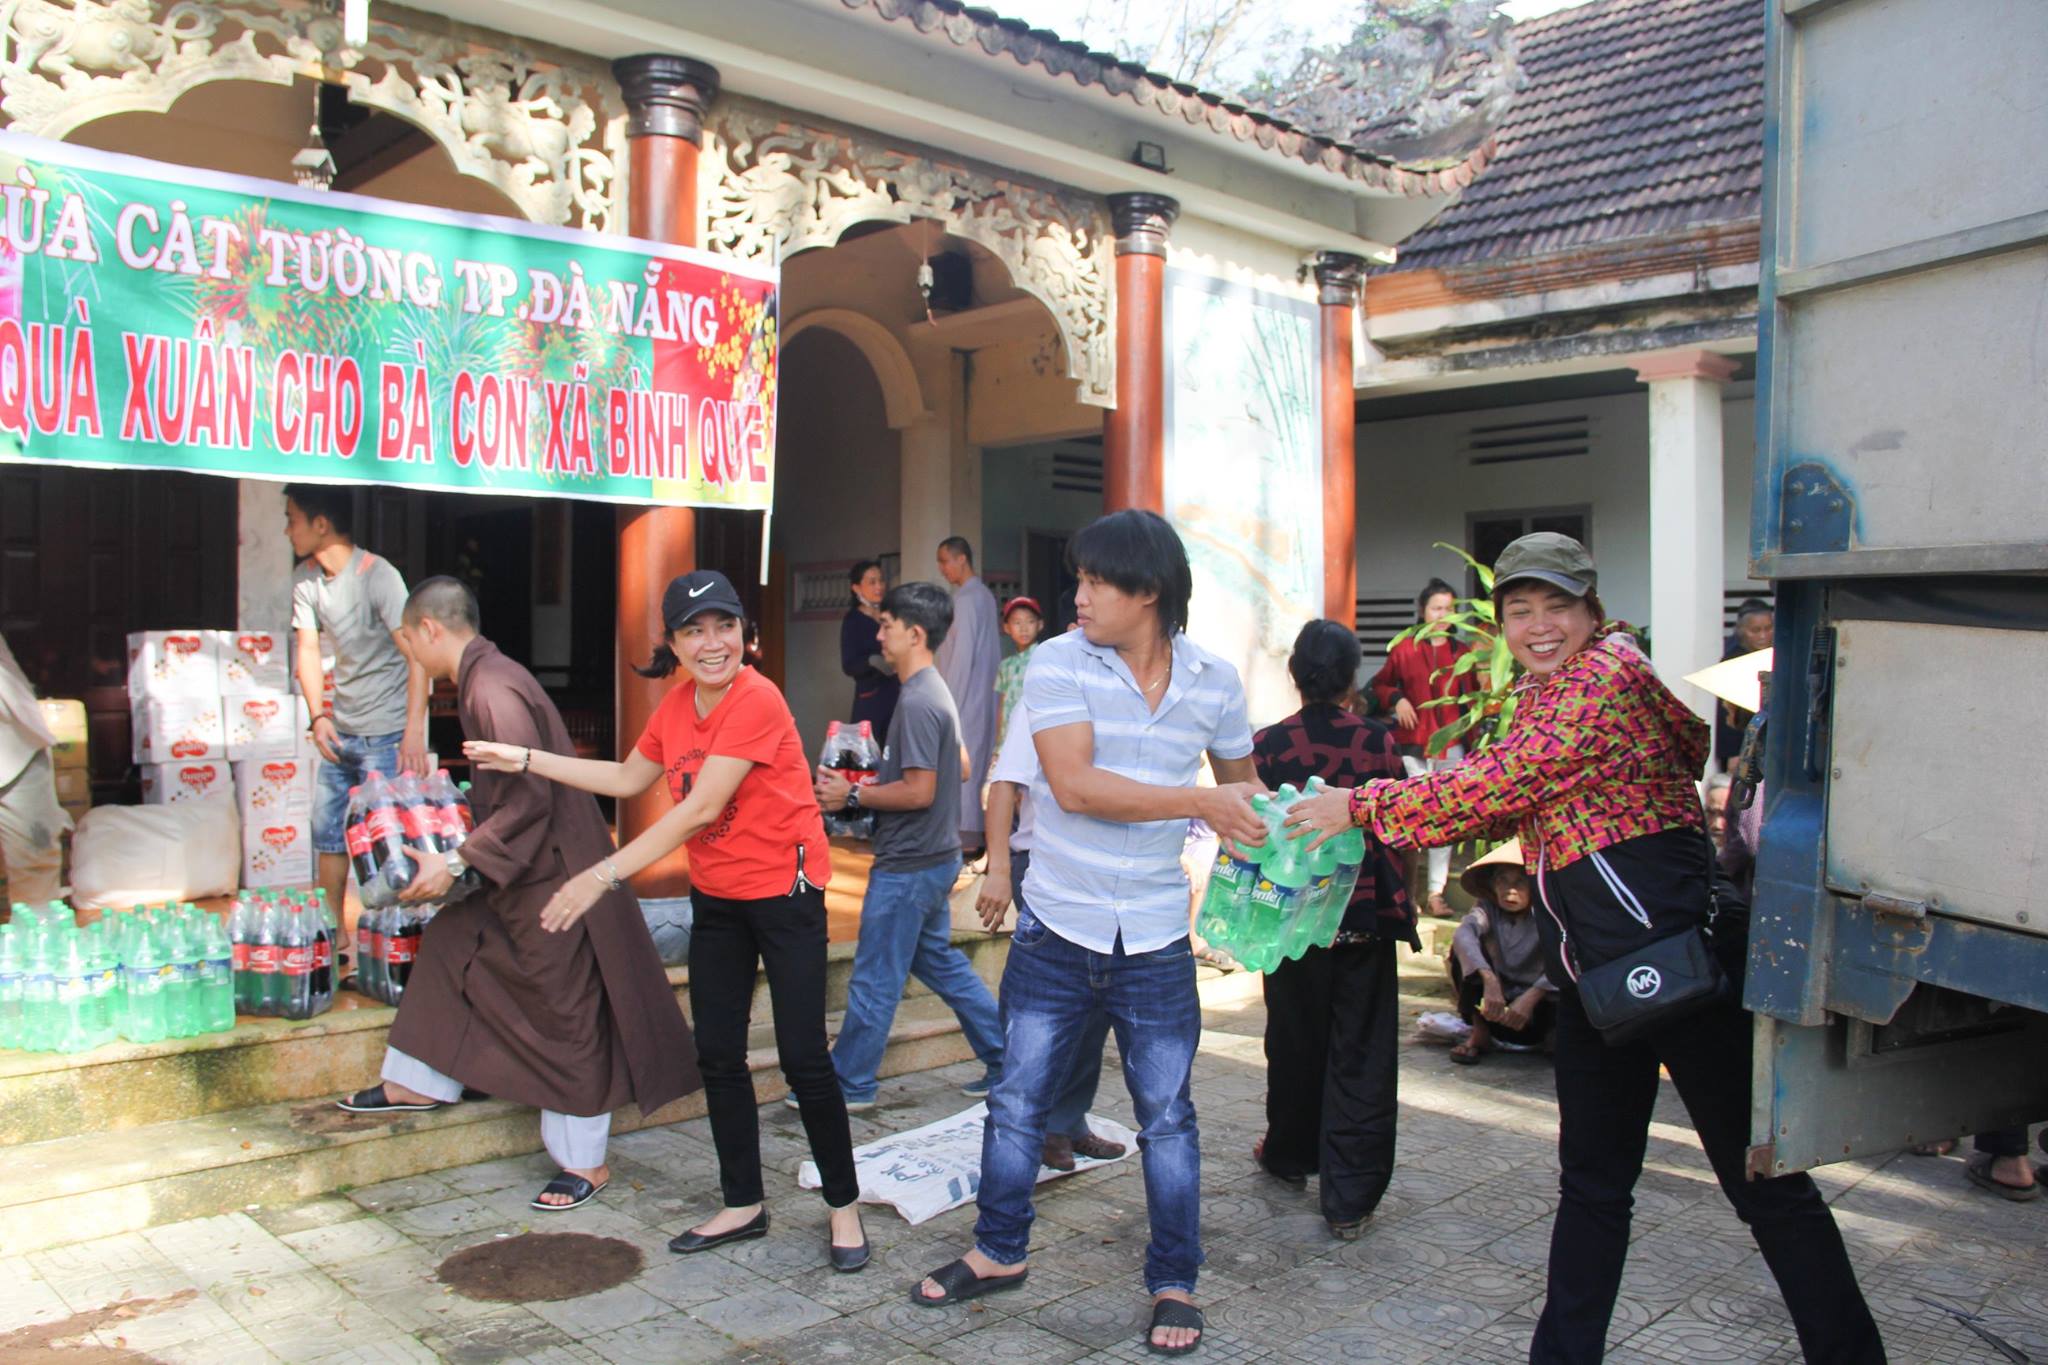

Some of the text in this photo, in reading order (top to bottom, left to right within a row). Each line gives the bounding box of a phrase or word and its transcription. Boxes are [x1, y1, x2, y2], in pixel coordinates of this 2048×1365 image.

[0, 166, 99, 263] ÙA
[259, 225, 442, 308] TƯỜNG
[0, 296, 103, 447] QUÀ
[120, 315, 256, 449] XUÂN
[272, 348, 365, 459] CHO
[378, 339, 435, 465] BÀ
[450, 369, 532, 471] CON
[543, 360, 597, 476] XÃ
[608, 366, 689, 480] BÌNH
[1630, 971, 1658, 992] MK
